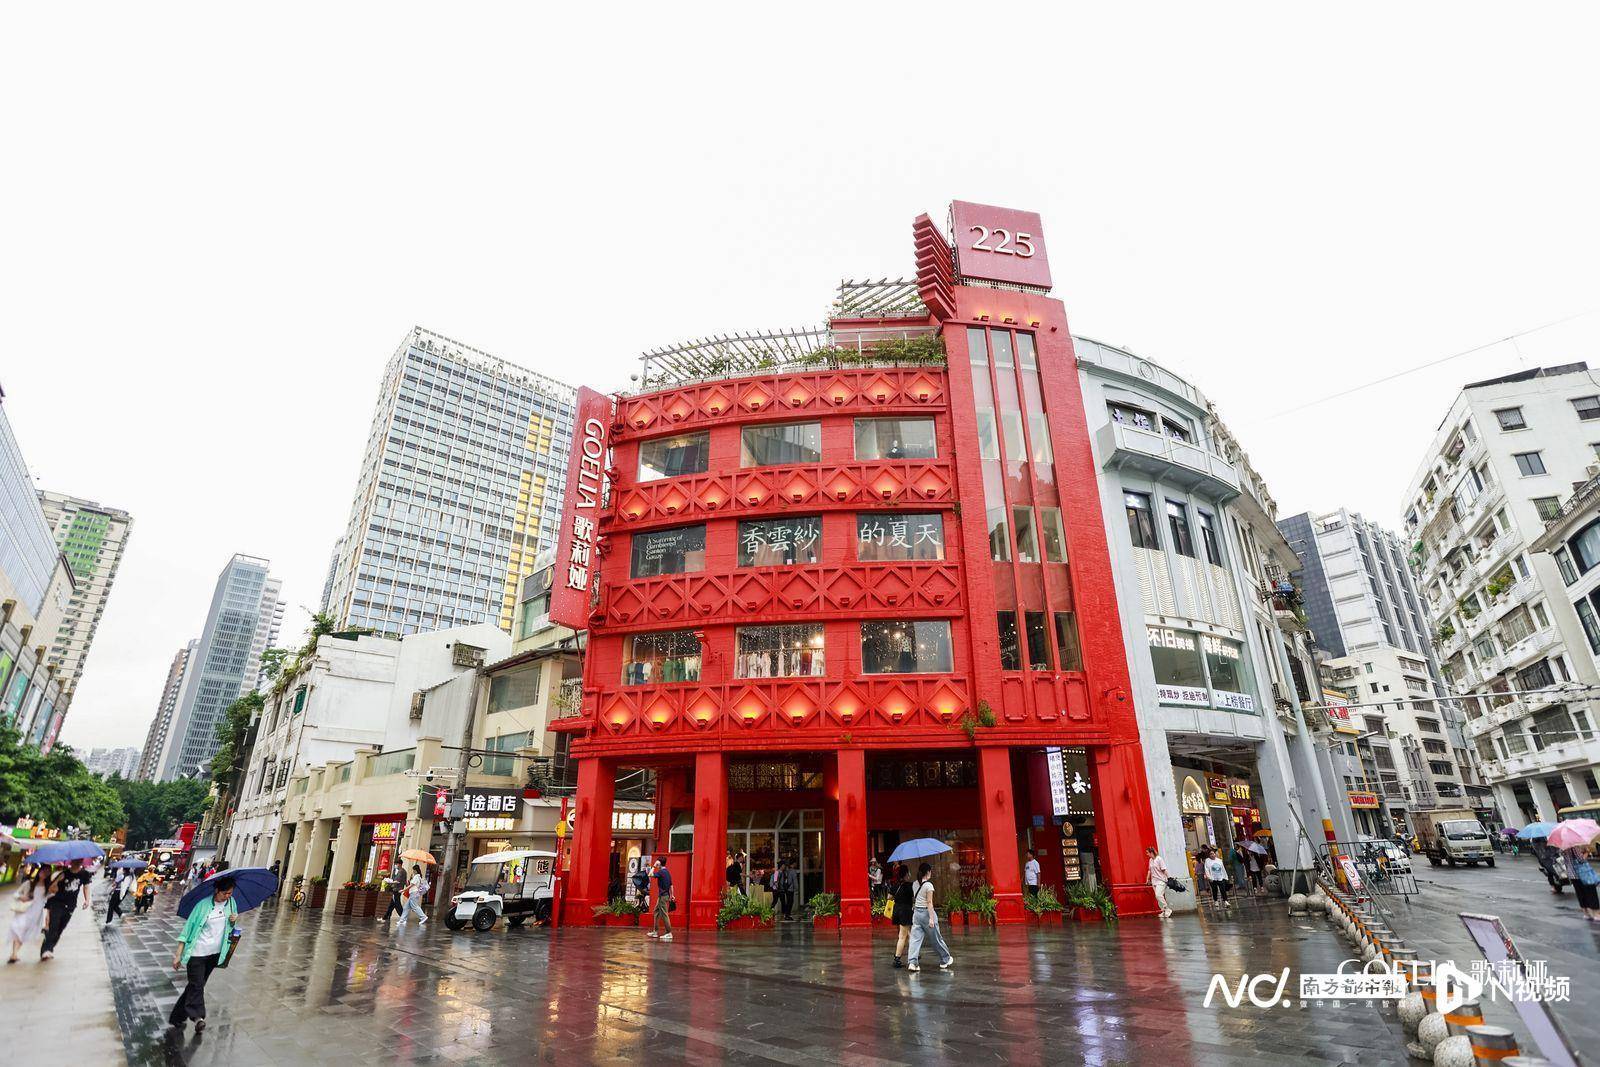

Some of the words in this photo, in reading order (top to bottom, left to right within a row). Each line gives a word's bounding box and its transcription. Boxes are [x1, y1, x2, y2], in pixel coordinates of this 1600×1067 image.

[970, 225, 1036, 258] 225
[575, 418, 605, 509] GOELIA
[565, 514, 595, 591] 歌莉娅
[859, 518, 942, 549] 的夏天
